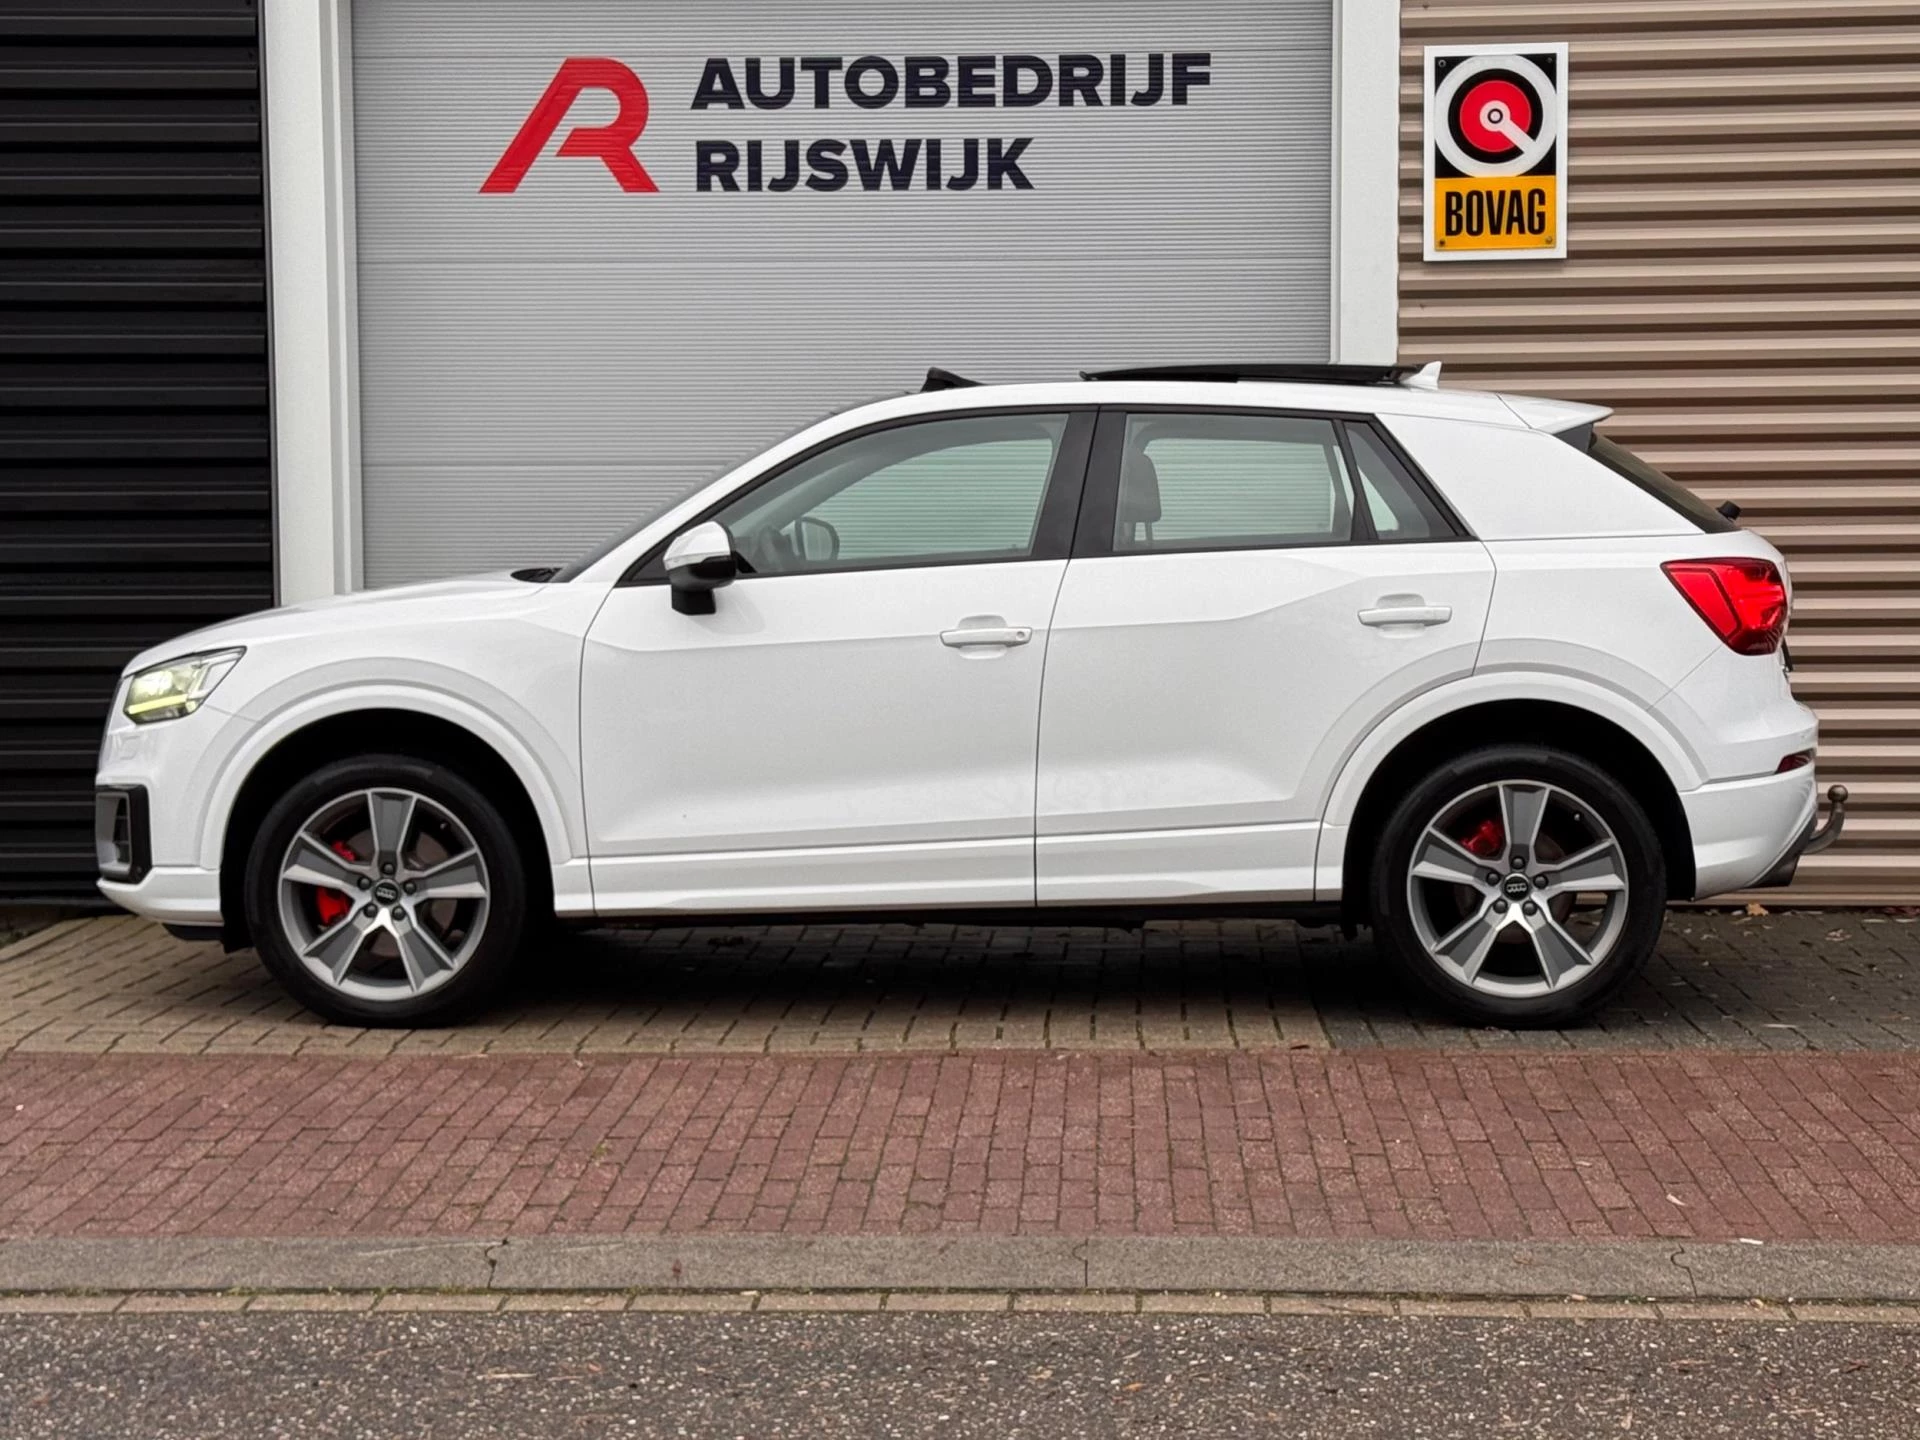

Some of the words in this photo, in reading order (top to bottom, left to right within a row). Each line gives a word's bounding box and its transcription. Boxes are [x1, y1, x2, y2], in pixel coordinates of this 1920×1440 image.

[690, 52, 1211, 110] AUTOBEDRIJF
[695, 137, 1035, 193] RIJSWIJK
[1445, 188, 1546, 237] BOVAG
